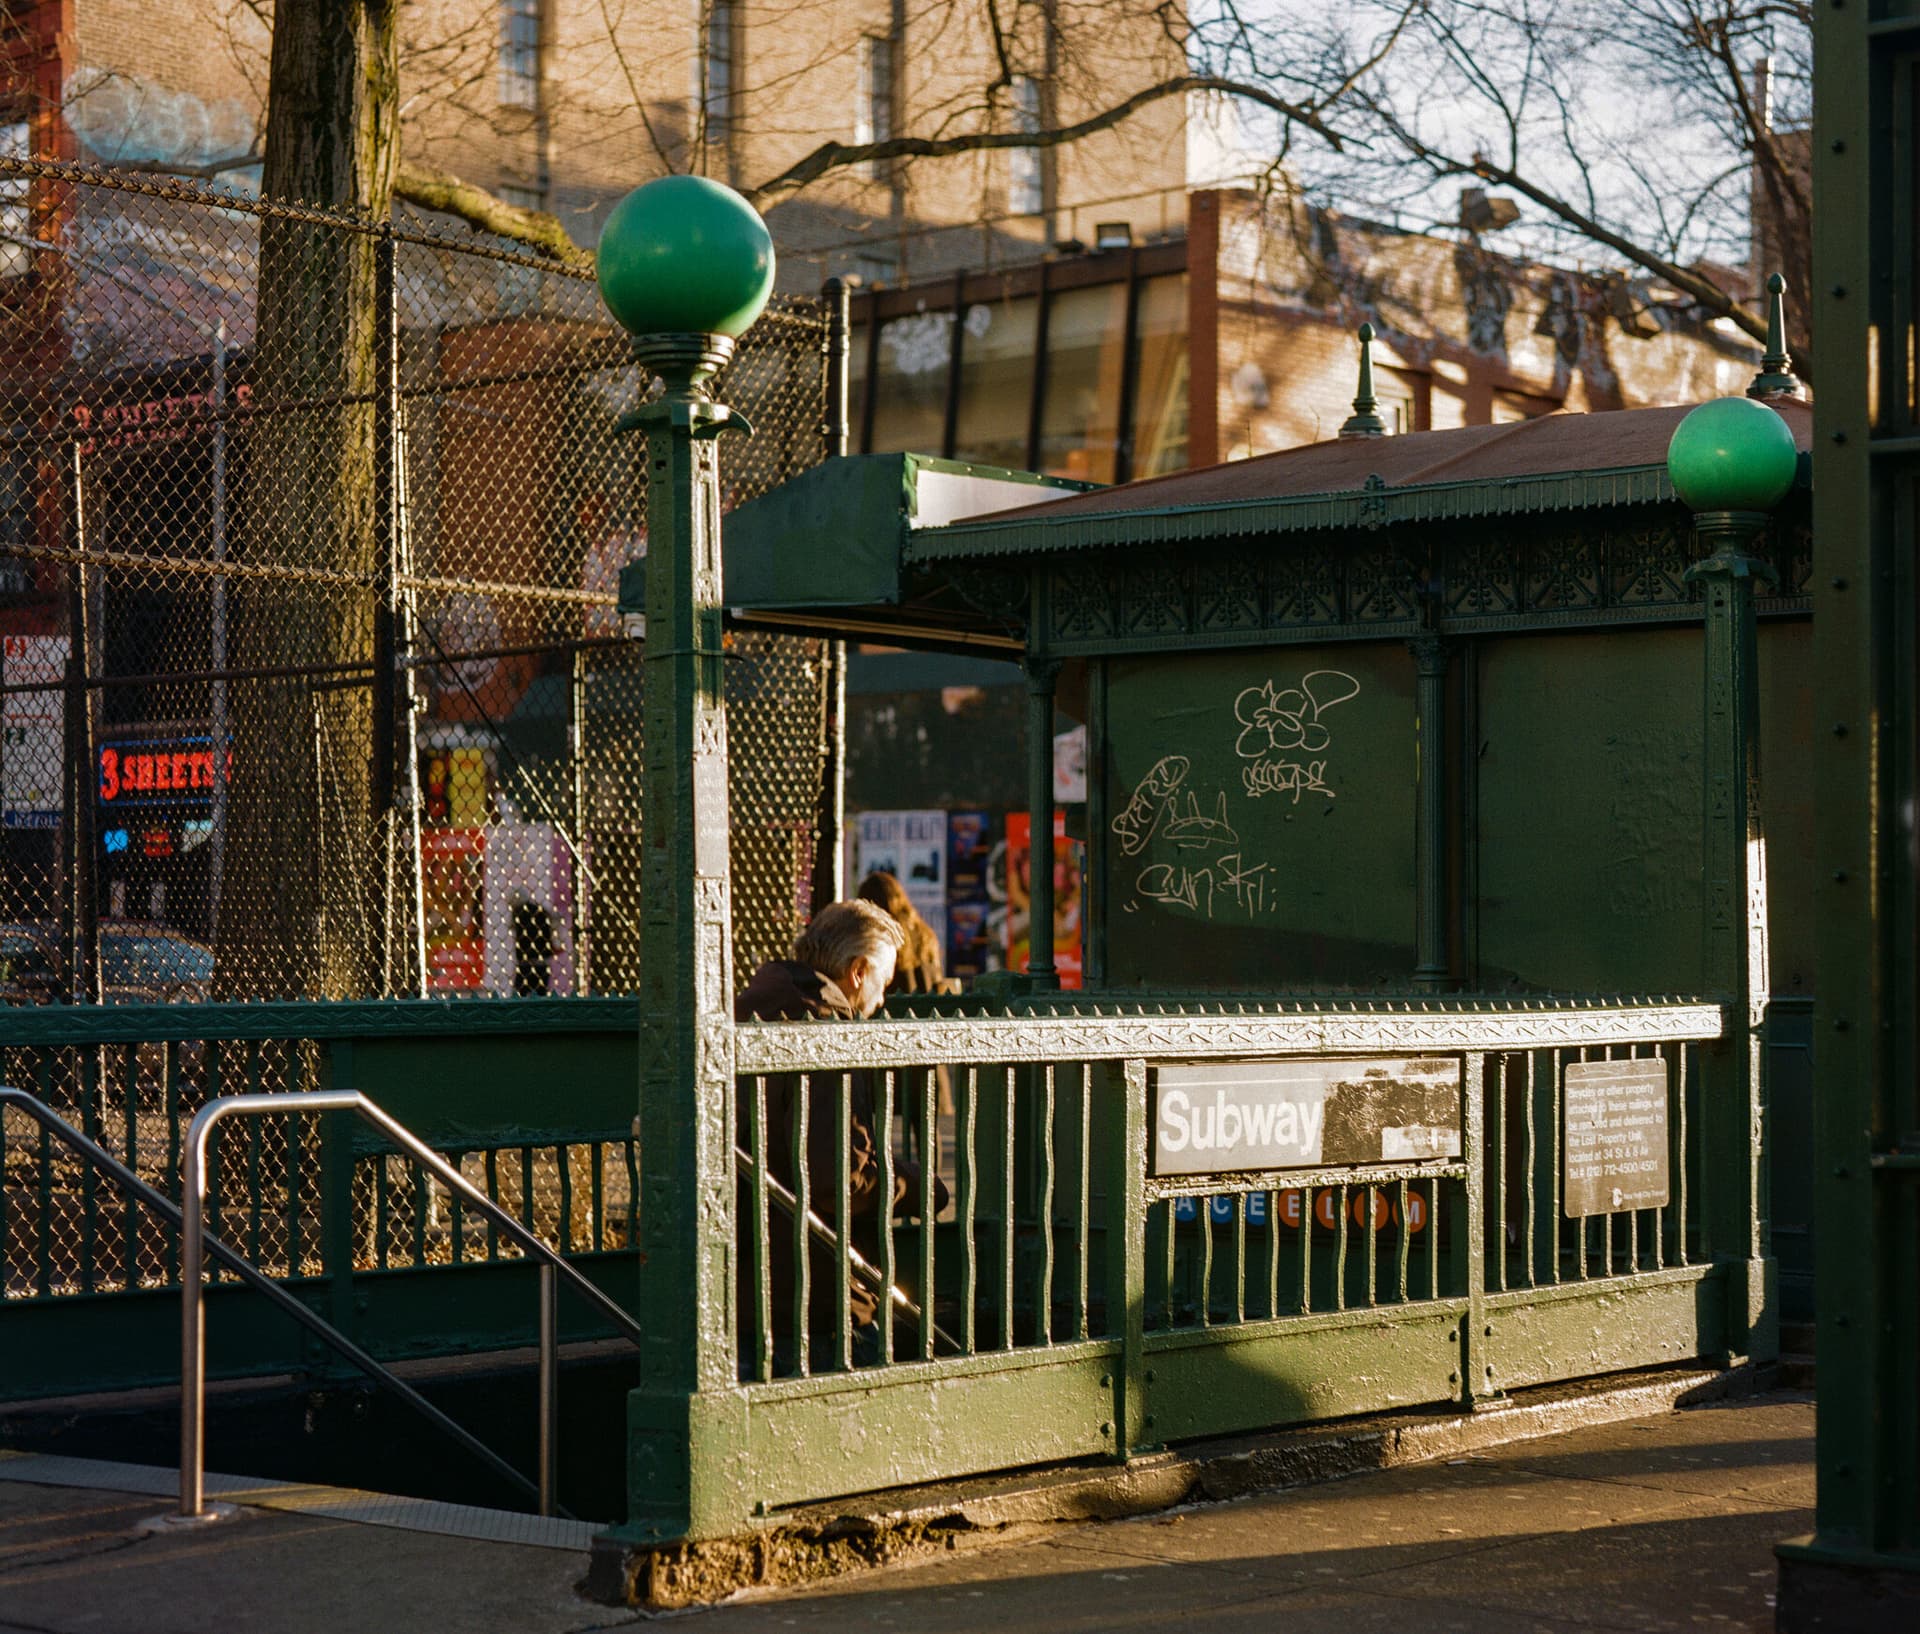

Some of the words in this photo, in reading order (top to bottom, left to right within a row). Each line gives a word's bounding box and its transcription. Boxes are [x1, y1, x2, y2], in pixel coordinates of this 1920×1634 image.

[101, 749, 120, 800] 3
[1597, 1087, 1605, 1097] or
[1606, 1085, 1624, 1096] other
[1625, 1083, 1654, 1096] property
[1158, 1088, 1323, 1157] Subway
[1609, 1116, 1622, 1128] and
[1597, 1132, 1627, 1146] Property
[1603, 1148, 1613, 1160] 34
[1176, 1194, 1193, 1212] A
[1212, 1193, 1228, 1215] C
[1250, 1193, 1265, 1216] E
